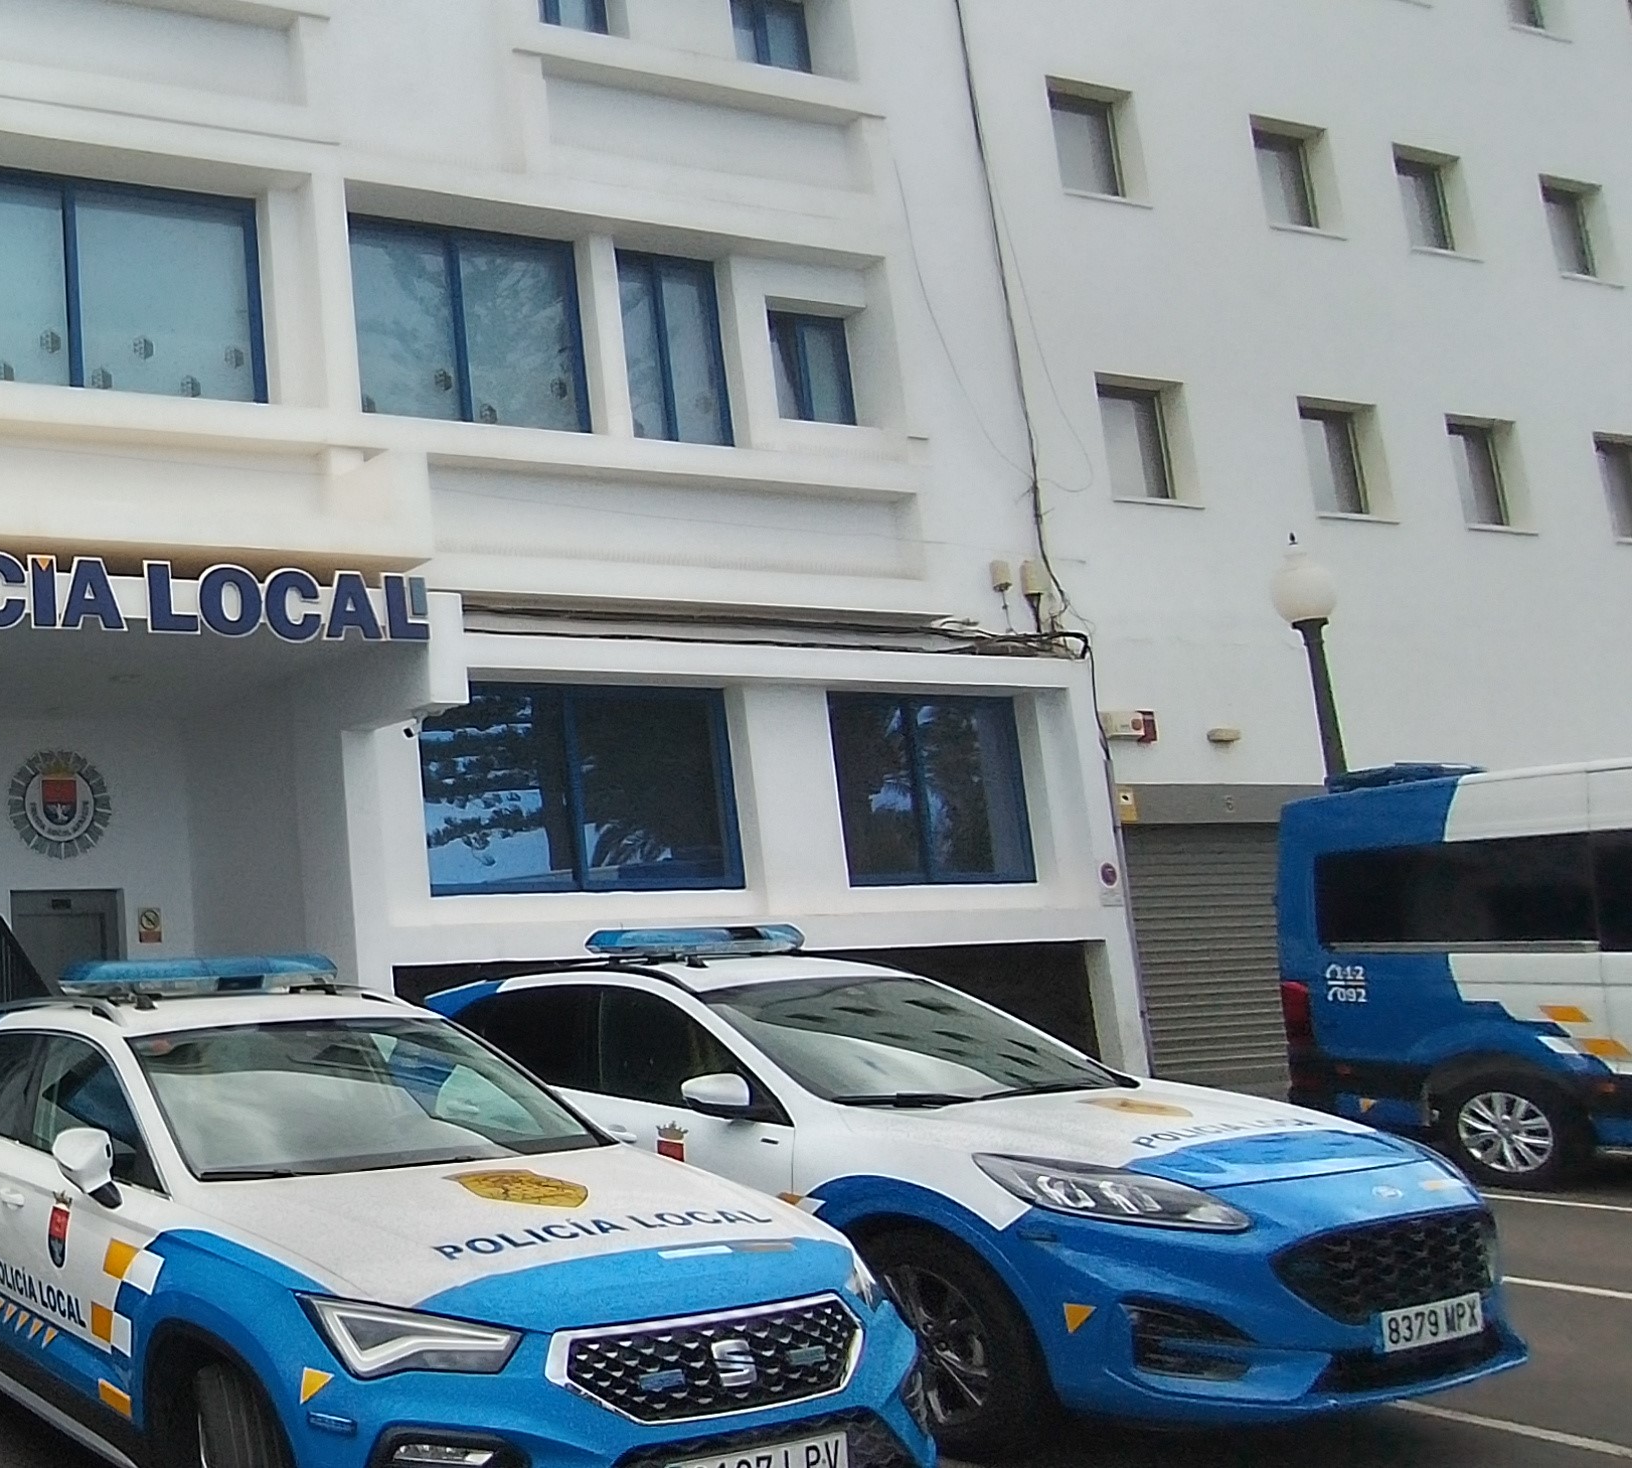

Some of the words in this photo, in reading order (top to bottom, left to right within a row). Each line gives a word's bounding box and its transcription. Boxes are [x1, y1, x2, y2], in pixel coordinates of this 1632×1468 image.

[143, 560, 431, 643] LOCAL
[627, 1209, 773, 1229] LOCAL
[38, 1280, 87, 1328] LOCAL
[1388, 1308, 1440, 1345] 8379
[1443, 1299, 1478, 1333] MPX
